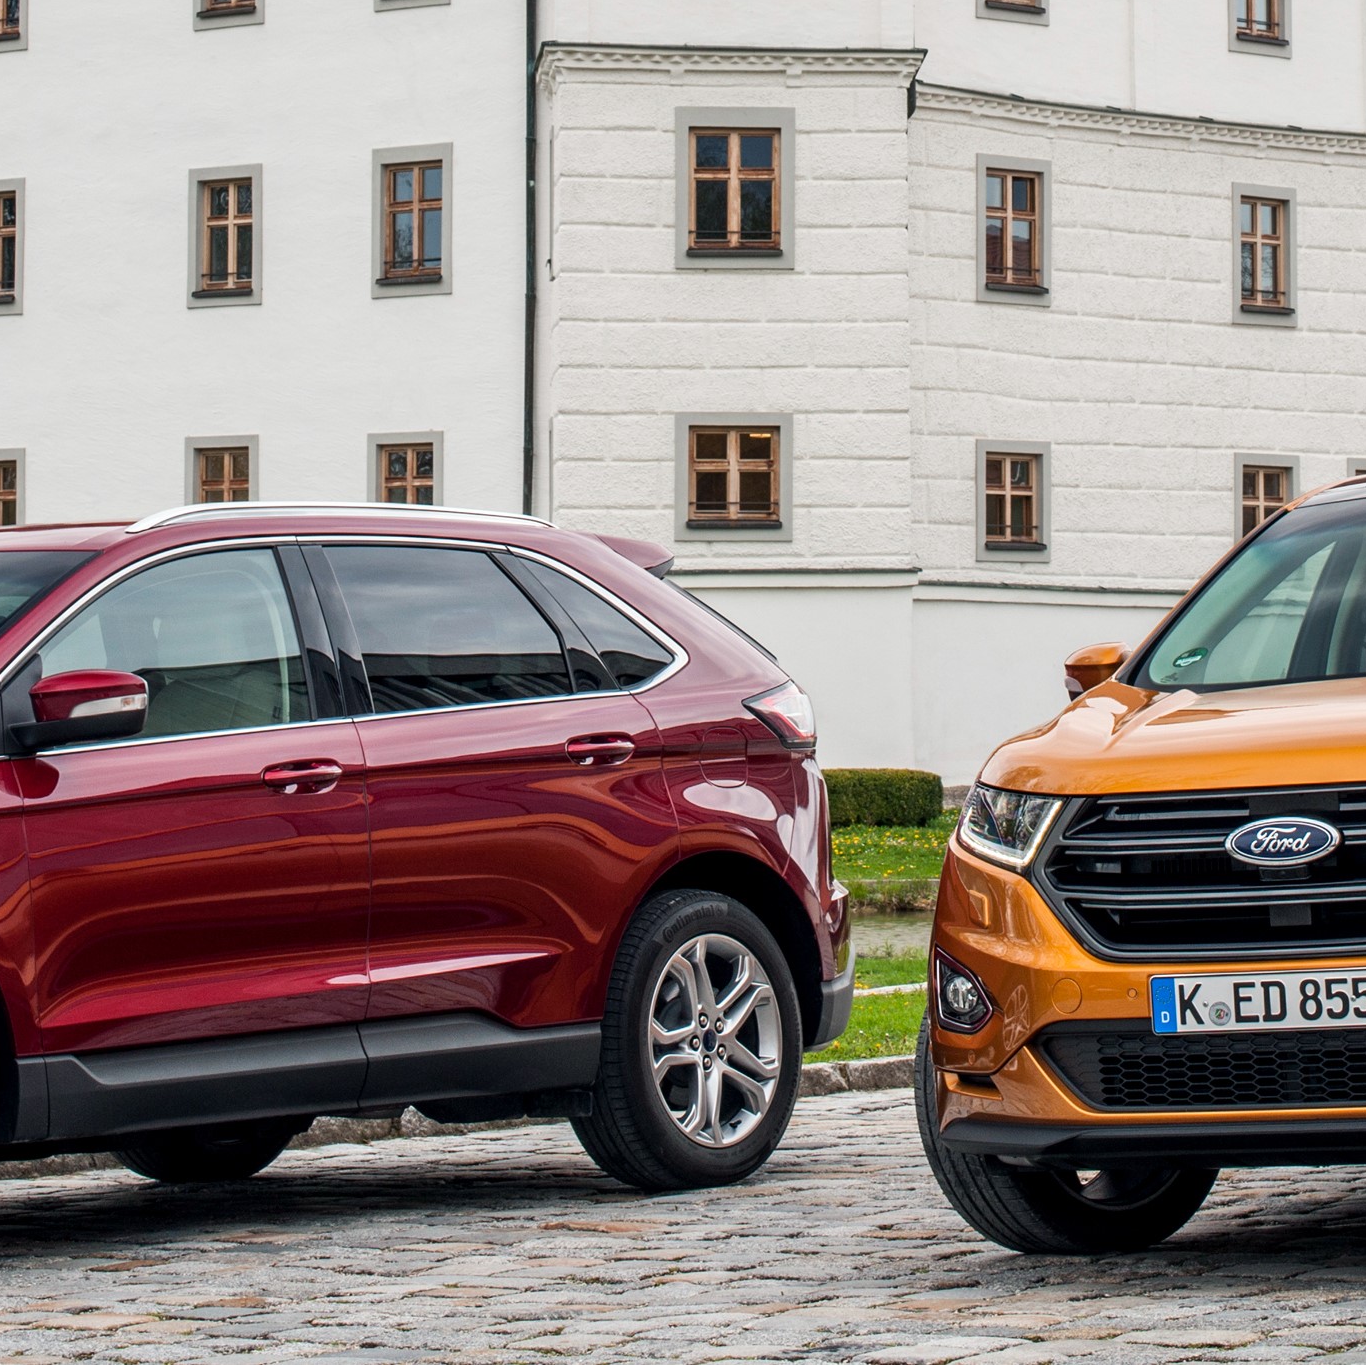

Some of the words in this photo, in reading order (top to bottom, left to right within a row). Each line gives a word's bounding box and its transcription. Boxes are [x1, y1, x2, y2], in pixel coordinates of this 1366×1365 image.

[1250, 827, 1312, 854] Ford
[662, 904, 715, 943] Continental
[1161, 1011, 1170, 1023] D
[1178, 983, 1205, 1025] K
[1233, 979, 1287, 1023] ED
